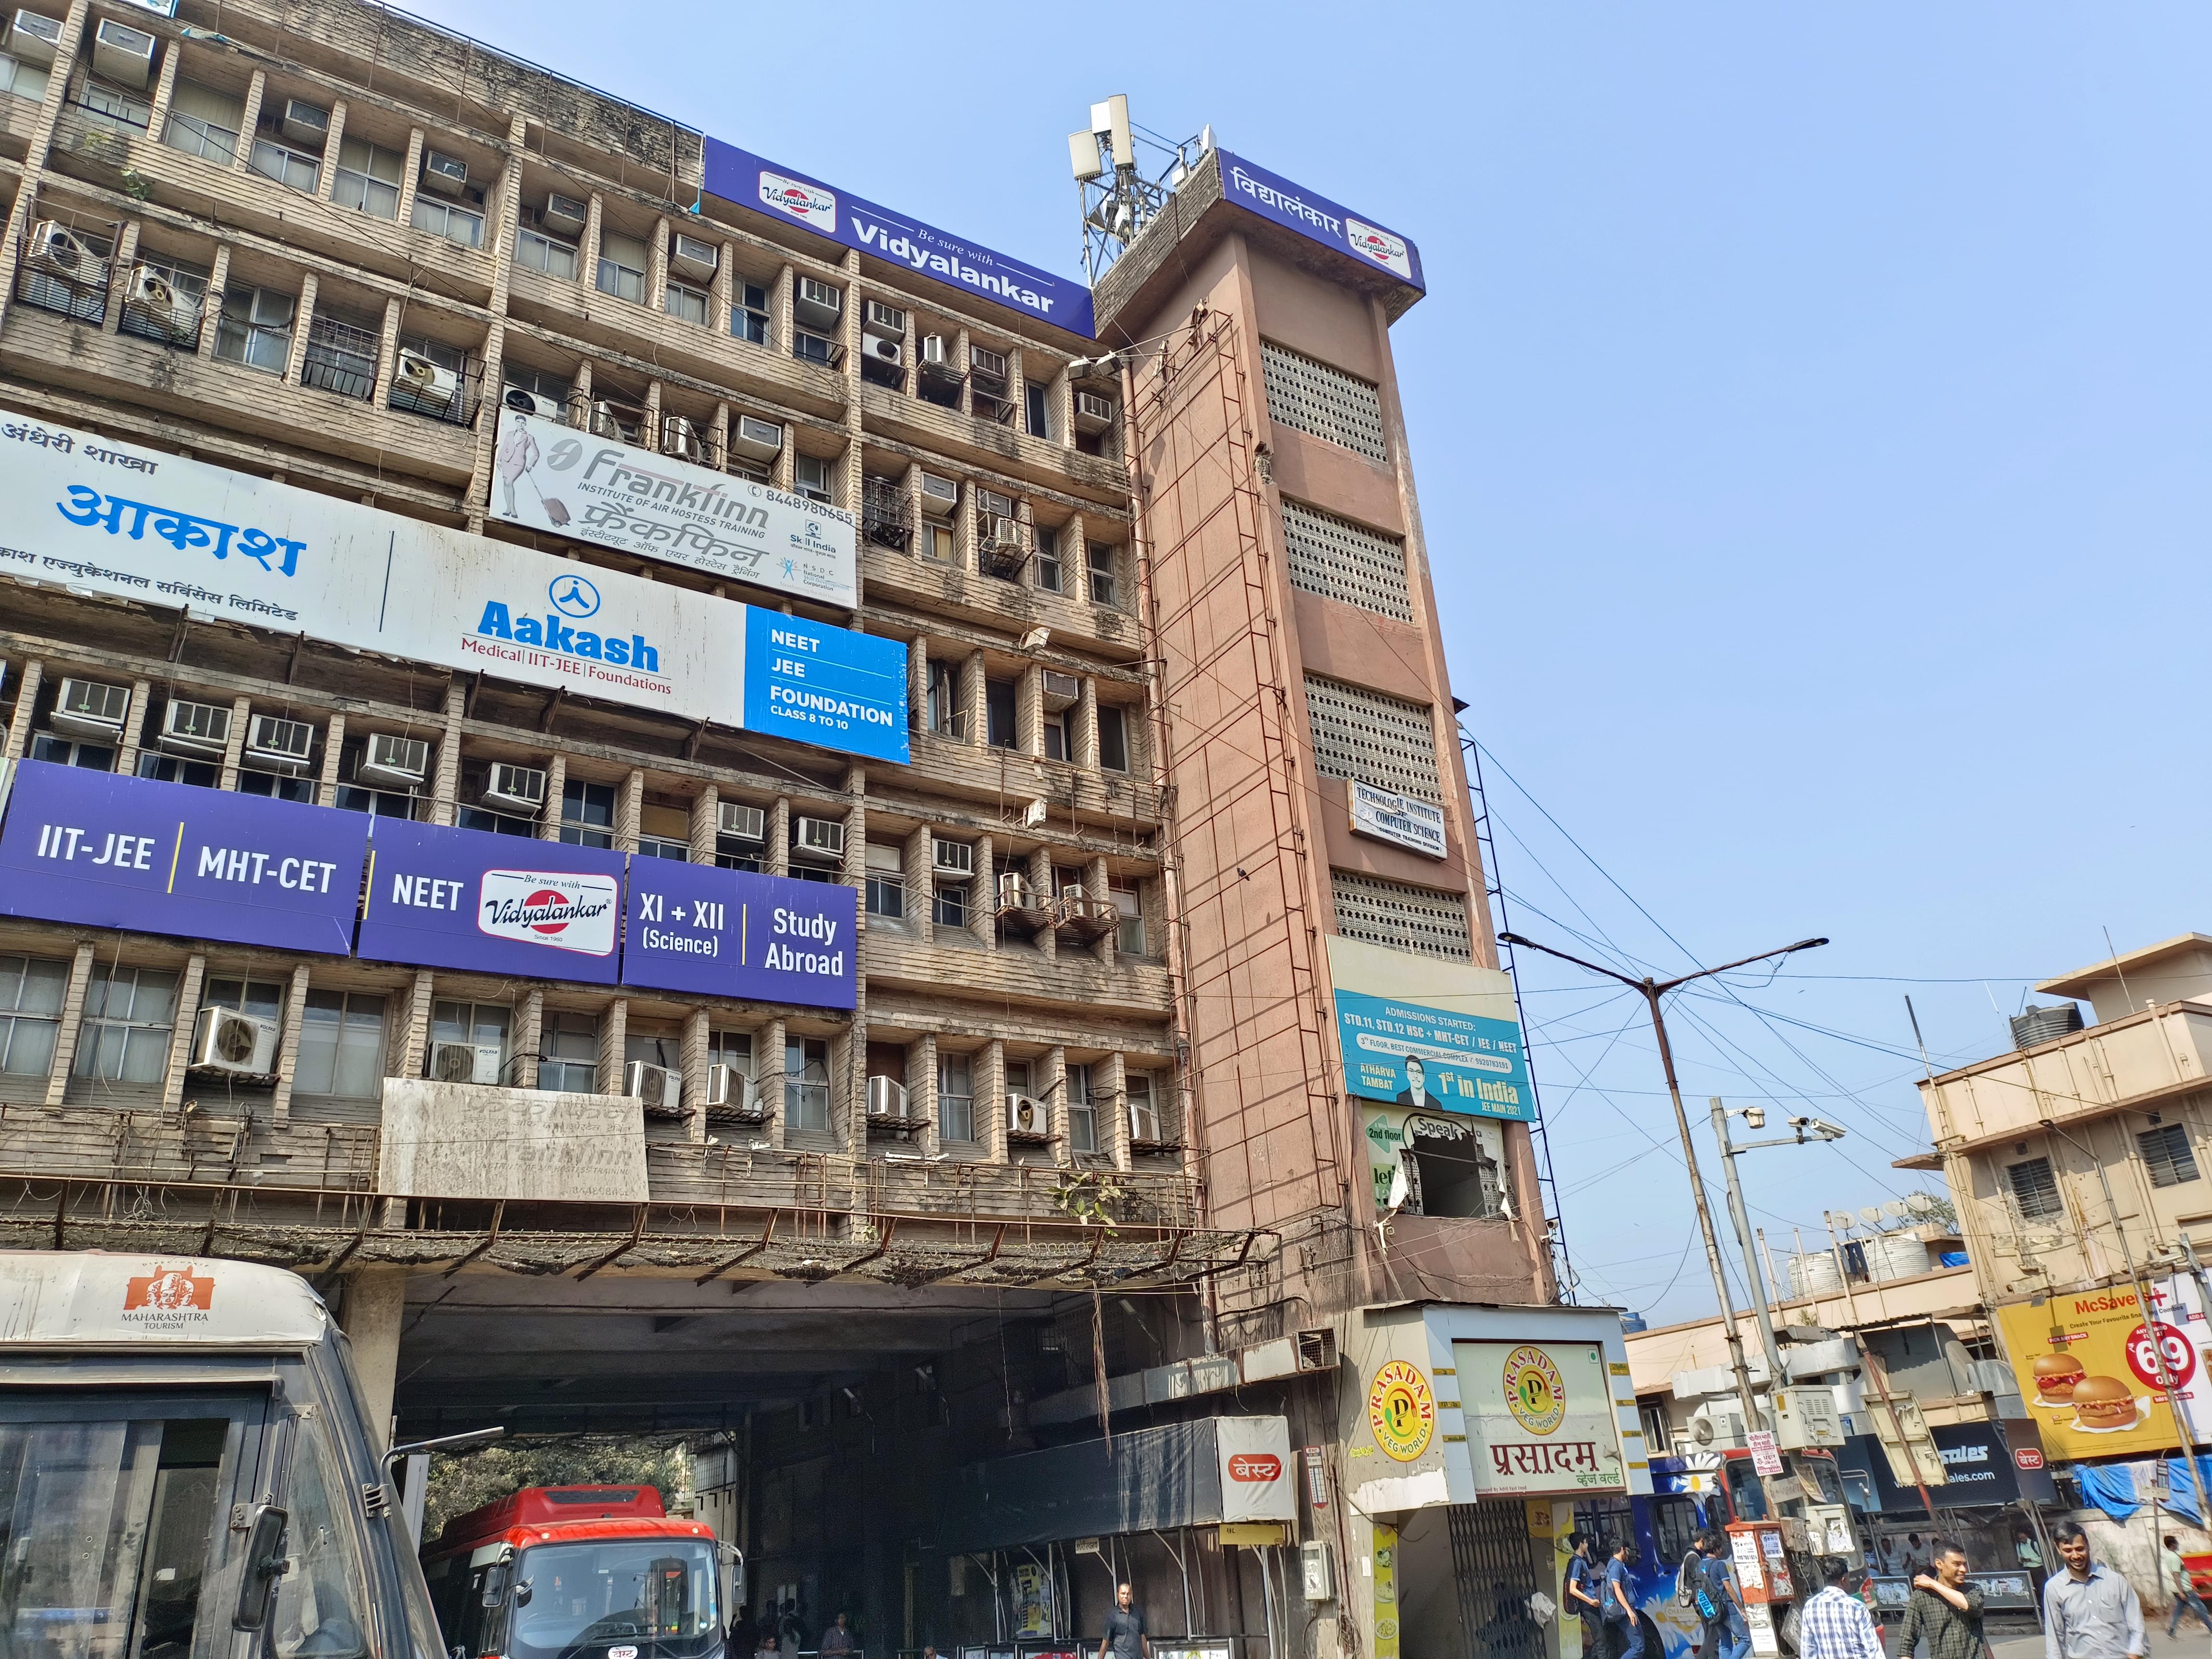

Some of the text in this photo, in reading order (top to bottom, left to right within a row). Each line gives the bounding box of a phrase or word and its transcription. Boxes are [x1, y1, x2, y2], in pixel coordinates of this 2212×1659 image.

[1230, 166, 1343, 239] विद्यालंकार
[917, 228, 994, 266] Be sure with
[851, 217, 1054, 314] Vidyalankar
[1, 423, 158, 475] अंधेरी शाखा
[577, 482, 766, 539] INSTITUTE OF AIR HOSTESS TRAINING
[767, 490, 853, 525] 8448980655
[56, 485, 307, 577] आकाश
[790, 534, 836, 553] Skll India
[634, 541, 660, 553] ऑफ
[666, 549, 690, 562] एयर
[695, 555, 728, 571] होस्टेस
[0, 547, 37, 565] काश
[156, 579, 224, 605] सर्विसेस
[229, 594, 299, 622] लिमिटेड
[804, 570, 825, 579] National
[804, 580, 833, 591] Corporation
[477, 601, 660, 673] Aakash
[771, 629, 821, 654] NEET
[528, 652, 581, 676] IIT-JEE
[589, 664, 672, 696] Foundations
[771, 657, 806, 679] JEE
[770, 686, 893, 727] FOUNDATION
[770, 705, 849, 731] CLASS 8 TO 10
[1376, 811, 1412, 833] COMPUTER
[1414, 824, 1440, 843] SCIENCE
[1406, 801, 1441, 824] INSTITUTE
[38, 824, 156, 870] IIT-JEE
[197, 846, 337, 893] MHT-CET
[523, 875, 580, 889] Be sure with
[392, 874, 464, 912] NEET
[640, 893, 723, 930] XI + XII
[773, 907, 837, 945] Study
[643, 928, 718, 958] (Science)
[765, 944, 843, 976] Abroad
[1344, 1013, 1375, 1031] STD.11,
[1376, 1019, 1405, 1035] STD.12
[1407, 1026, 1424, 1038] HSC
[1434, 1030, 1469, 1046] MHT-CET
[1478, 1037, 1491, 1049] JEE
[1498, 1041, 1517, 1054] NEET
[1385, 1006, 1476, 1031] ADMISSIONS STARTED:
[1370, 1039, 1390, 1050] FLOOR,
[1391, 1043, 1405, 1052] BEST
[1406, 1046, 1442, 1058] COMMERCIAL
[1443, 1053, 1468, 1063] COMPLEX
[1475, 1058, 1509, 1070] 9920783191
[1360, 1063, 1396, 1079] ATHARVA
[1361, 1075, 1393, 1091] TAMBAT
[1439, 1071, 1519, 1104] 1st in India
[1481, 1101, 1521, 1116] JEE MAIN 2021
[1369, 1128, 1401, 1141] 2nd floor
[1418, 1118, 1458, 1138] Speak
[121, 1313, 208, 1322] MAHARASHTRA
[2103, 1315, 2130, 1323] Favourite
[2131, 1309, 2157, 1319] Snaing
[2159, 1306, 2184, 1314] Combos
[1506, 1349, 1563, 1403] PRASADAM
[2155, 1374, 2179, 1384] Oly
[1372, 1364, 1432, 1429] PRASADAM
[1518, 1406, 1561, 1430] VEG WORLD
[1383, 1431, 1399, 1453] VEG
[1399, 1429, 1426, 1455] WORLD
[2019, 1448, 2040, 1466] बेस्ट
[1233, 1457, 1276, 1478] बेस्ट
[1576, 1467, 1621, 1487] व्हेज वर्ल्ड
[612, 1647, 634, 1658] बेस्ट
